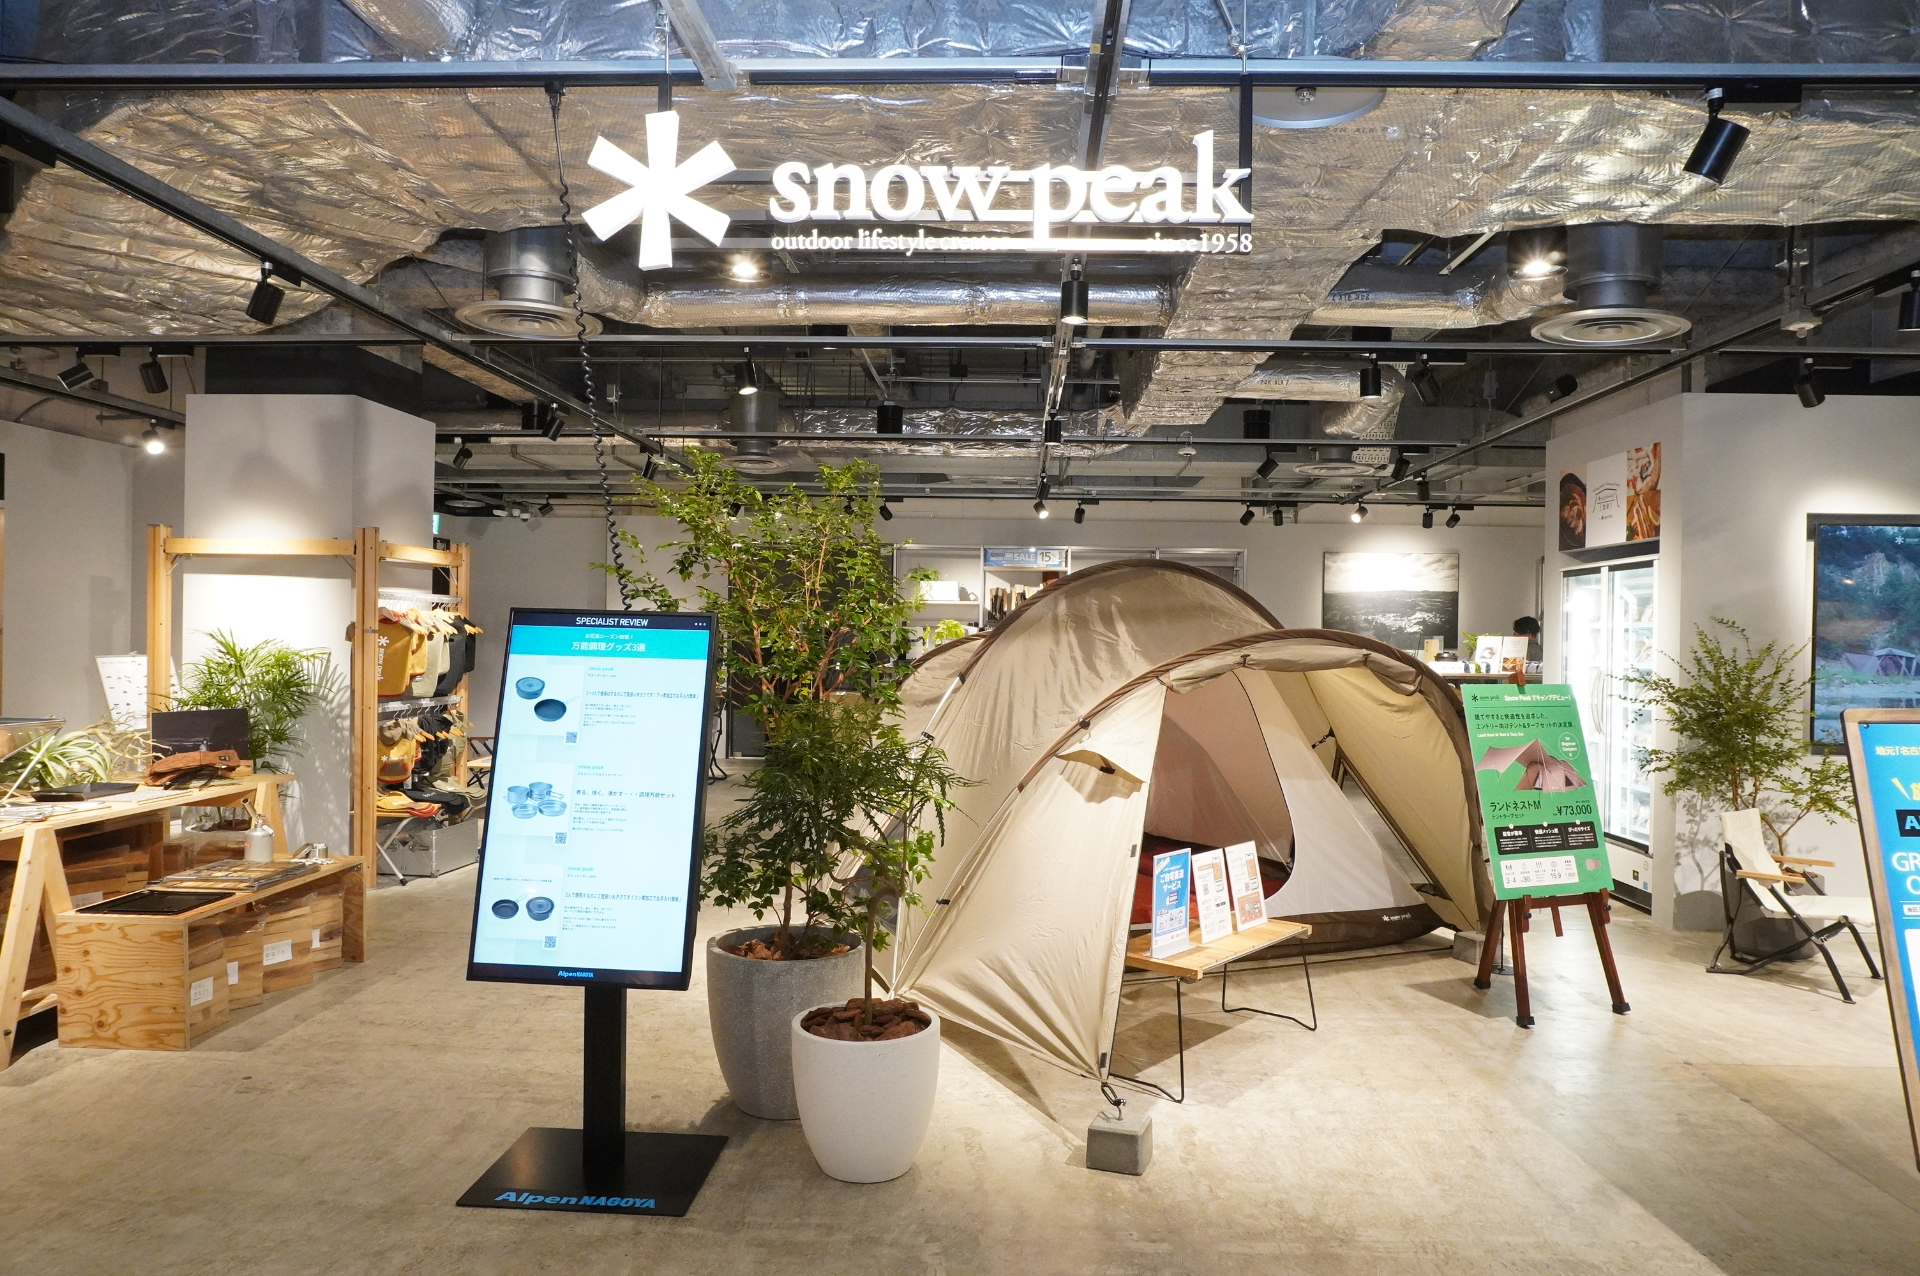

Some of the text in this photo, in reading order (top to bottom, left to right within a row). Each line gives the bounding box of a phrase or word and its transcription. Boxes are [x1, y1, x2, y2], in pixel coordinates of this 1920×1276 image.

[769, 129, 1255, 252] snow peak
[771, 228, 853, 250] outdoor
[858, 228, 935, 256] lifestyle
[939, 235, 1013, 250] creator
[1014, 553, 1036, 561] SALE
[576, 616, 649, 627] SPECIALIST REVIEW
[571, 641, 646, 652] 万能調理グッズ3選
[1875, 745, 1920, 756] 地元「名古
[1489, 800, 1542, 813] ランドネストM
[1556, 804, 1592, 817] ¥73,000
[494, 1191, 656, 1209] Alpen NAGOYA
